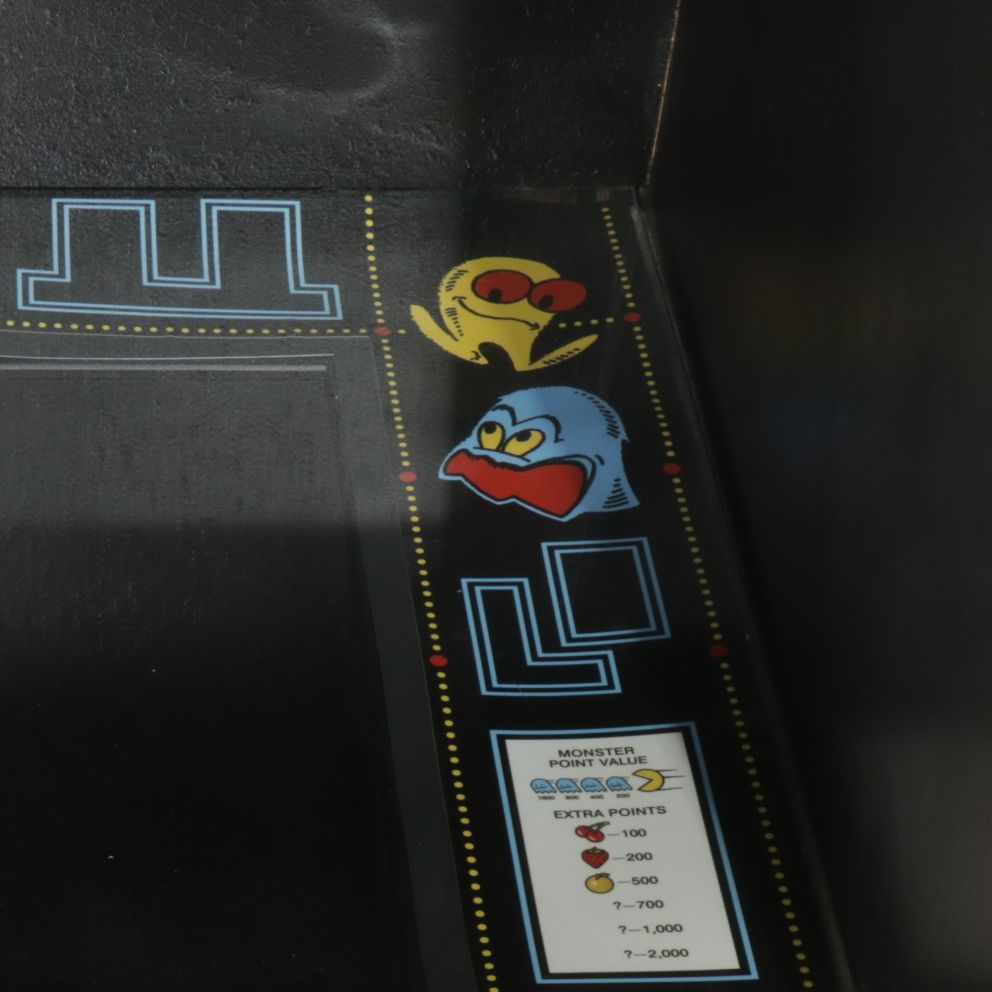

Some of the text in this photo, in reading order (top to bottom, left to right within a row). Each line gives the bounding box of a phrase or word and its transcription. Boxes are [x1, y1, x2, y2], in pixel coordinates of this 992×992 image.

[558, 746, 635, 758] MONSTER
[549, 756, 648, 768] POINT VALUE
[553, 806, 666, 819] EXTRA POINTS
